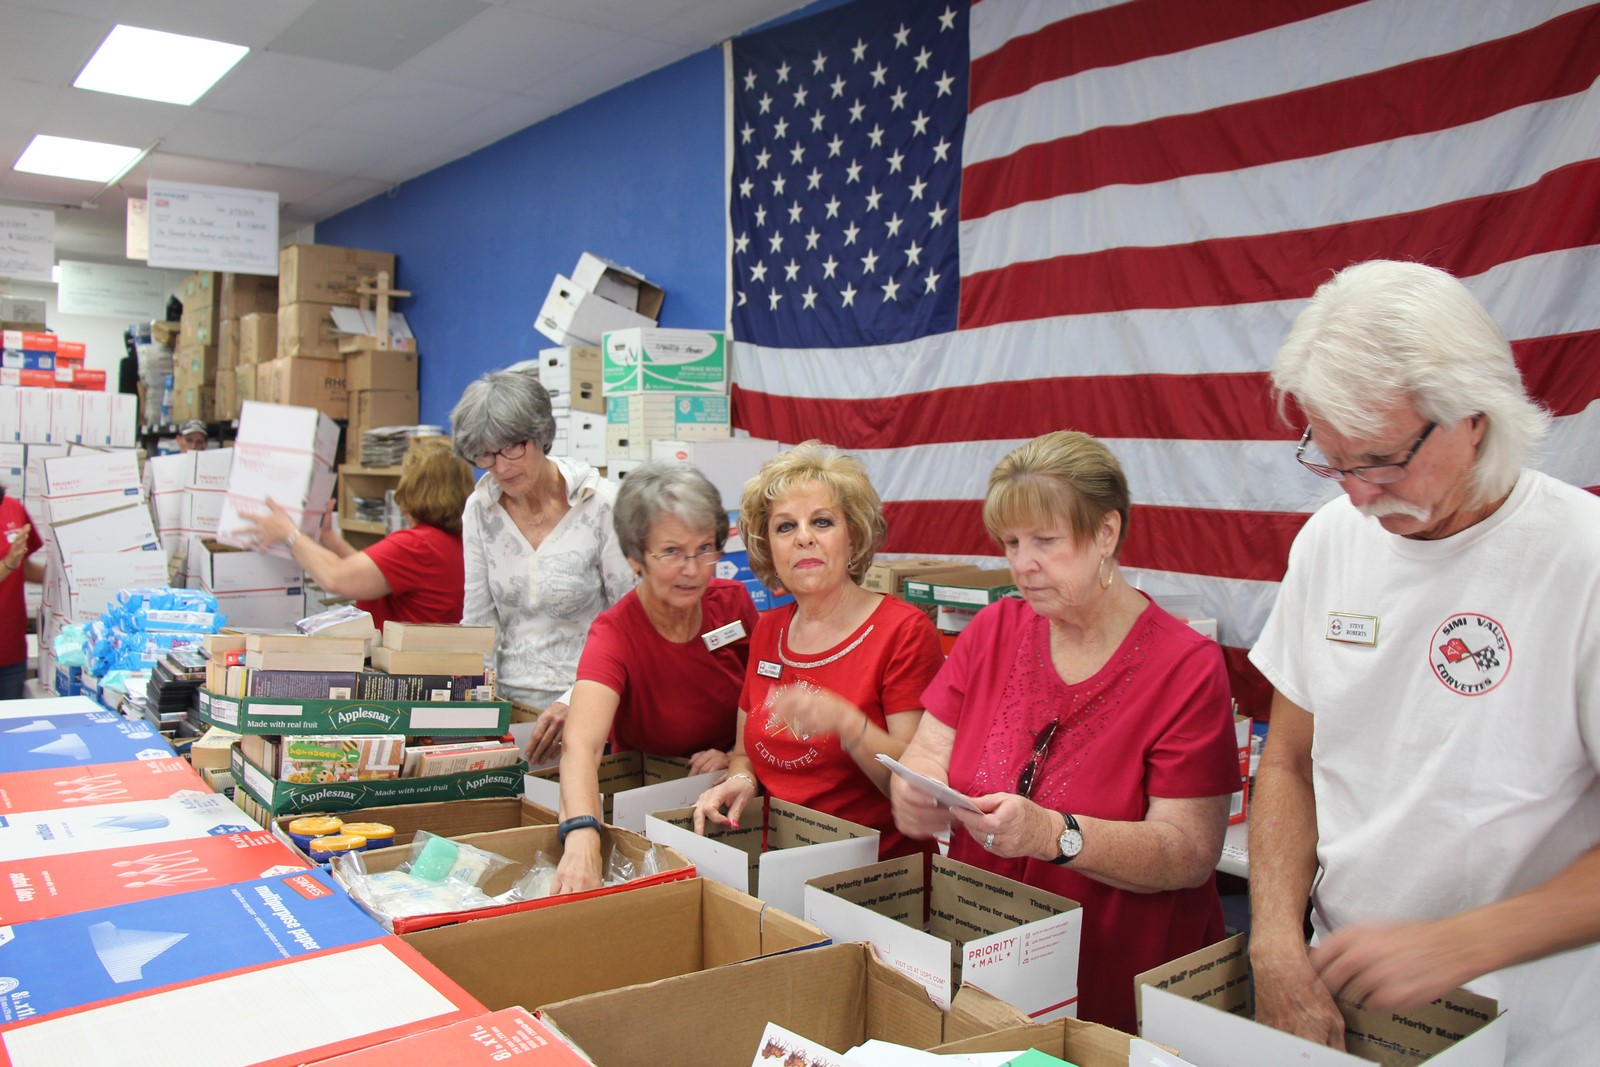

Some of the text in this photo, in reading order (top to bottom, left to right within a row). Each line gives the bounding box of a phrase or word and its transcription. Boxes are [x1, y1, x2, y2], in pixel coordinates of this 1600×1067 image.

[52, 479, 81, 487] PRIORITY
[1346, 629, 1367, 637] ROBERTS
[1442, 617, 1507, 652] SIMI VALLEY
[1436, 663, 1493, 693] CORVETTES
[338, 707, 391, 724] Applesnax
[247, 720, 318, 729] Made with real fruit
[755, 740, 818, 770] CORVETTES
[374, 783, 449, 797] Made with real fruit
[465, 774, 514, 790] Applesnax
[300, 788, 357, 803] Applesnax
[667, 817, 693, 825] Priority
[796, 815, 815, 826] postage
[816, 821, 838, 833] required
[726, 827, 752, 837] postage
[795, 834, 810, 844] Thank
[292, 876, 325, 897] STAPLES
[836, 879, 862, 891] Priority
[883, 868, 908, 879] Service
[957, 874, 983, 888] postage
[985, 882, 1014, 898] required
[957, 895, 1023, 926] Thank you for using
[1030, 898, 1051, 913] Thank
[254, 885, 321, 950] multipurpose paper
[955, 918, 982, 932] postage
[968, 938, 1015, 960] PRIORITY
[895, 959, 906, 968] VISIT
[979, 954, 1003, 968] MAIL
[1189, 961, 1215, 978] postage
[1216, 949, 1242, 965] required
[1192, 990, 1212, 1001] Thank
[1213, 985, 1225, 995] you
[1445, 1001, 1489, 1021] Service
[1392, 1013, 1432, 1034] Priority
